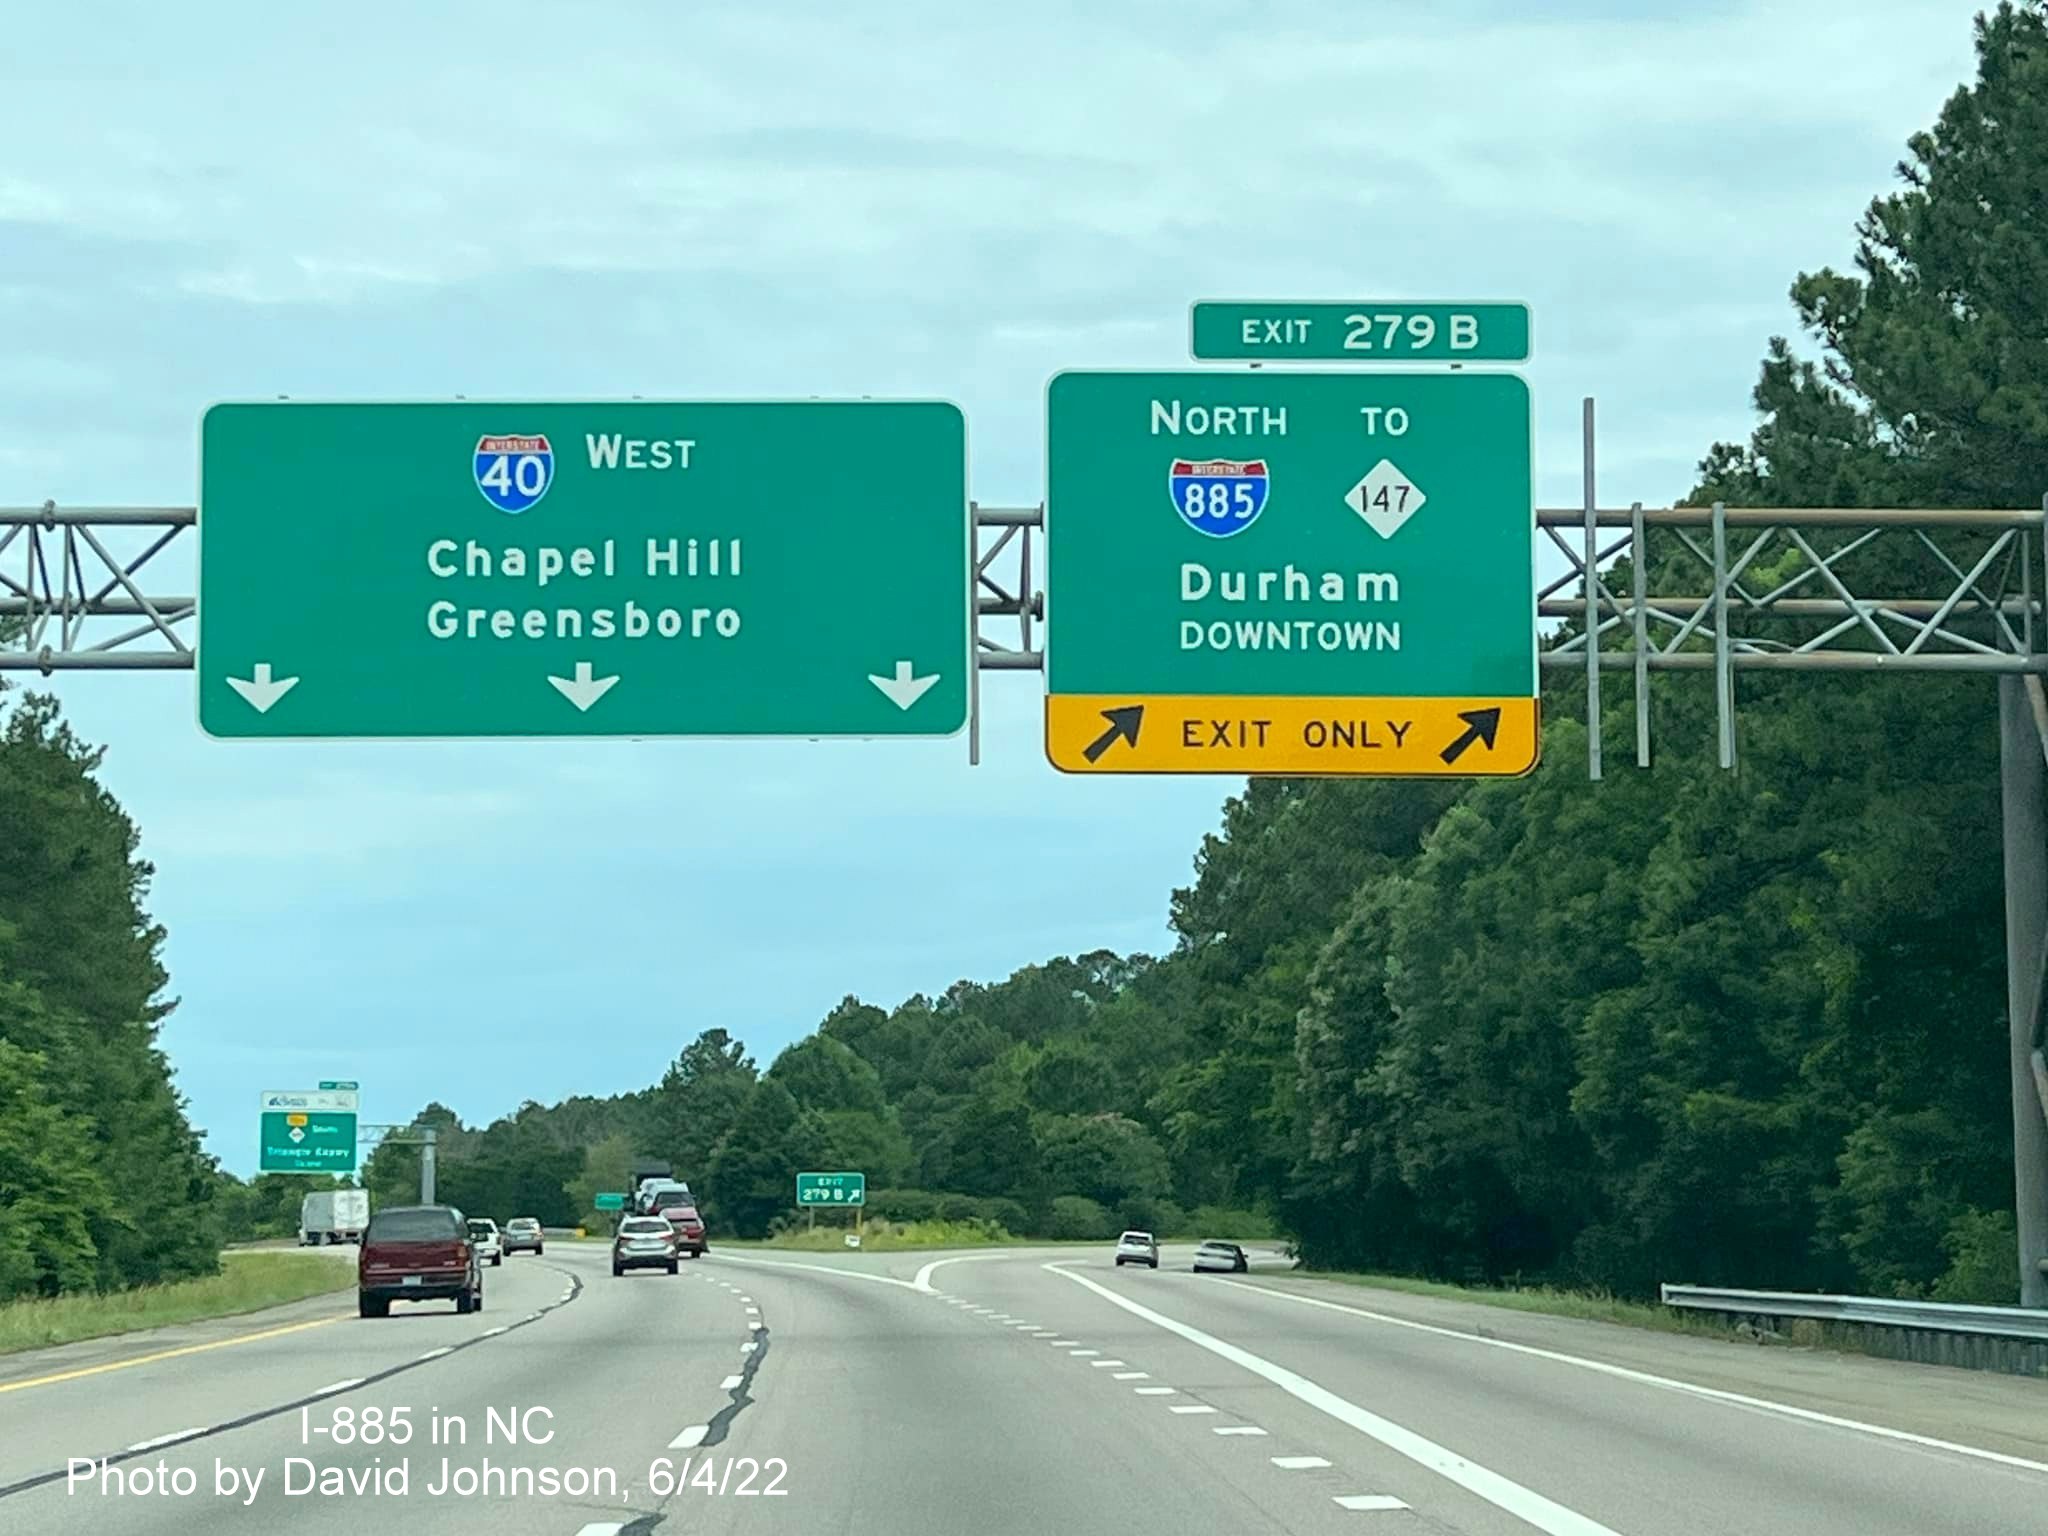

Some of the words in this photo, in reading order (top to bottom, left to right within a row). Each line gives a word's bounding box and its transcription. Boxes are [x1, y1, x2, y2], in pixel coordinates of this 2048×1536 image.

[1243, 319, 1311, 343] EXIT
[1344, 314, 1435, 349] 279
[1450, 315, 1478, 349] B
[1151, 400, 1286, 435] NORTH
[1361, 407, 1409, 436] TO
[586, 434, 695, 469] WEST
[481, 455, 546, 497] 40
[1185, 483, 1254, 519] 885
[1360, 485, 1410, 513] 147
[428, 539, 614, 586] Chapel
[647, 539, 740, 576] Hill
[1181, 563, 1398, 601] Durham
[428, 601, 740, 638] Greensboro
[1181, 621, 1400, 650] DOWNTOWN
[1182, 719, 1272, 748] EXIT
[1303, 719, 1412, 749] ONLY
[803, 1188, 830, 1201] 279
